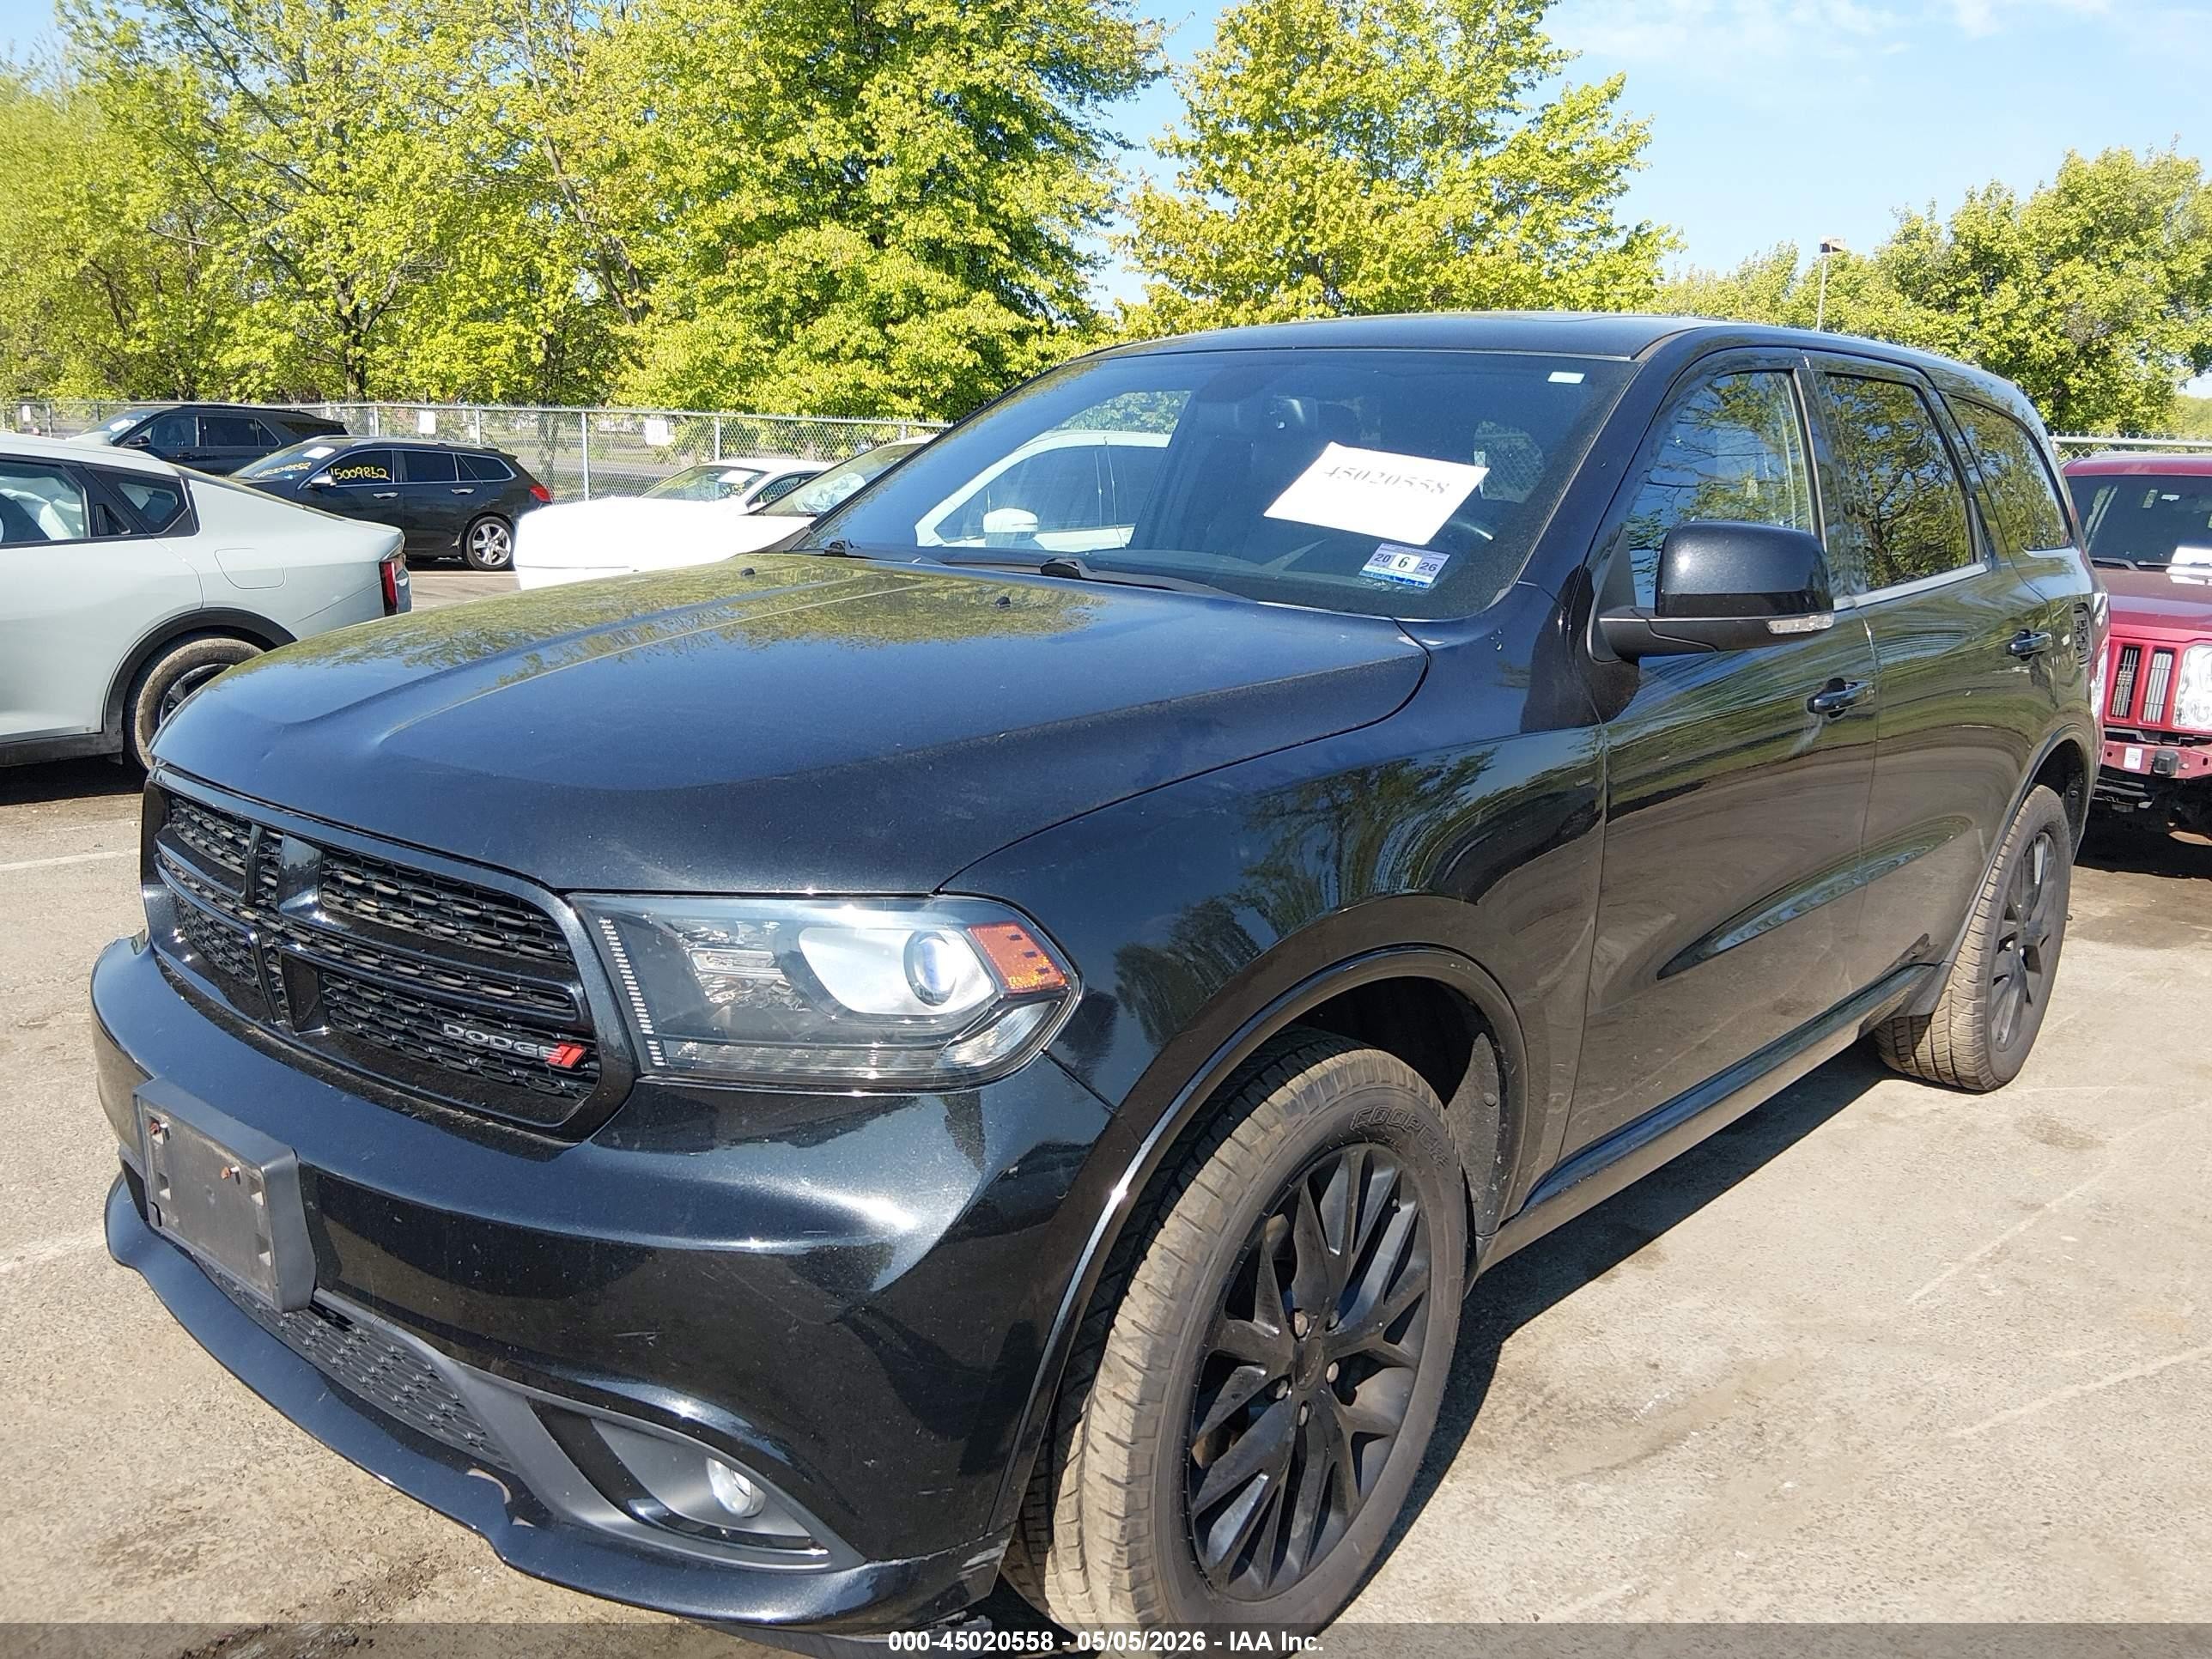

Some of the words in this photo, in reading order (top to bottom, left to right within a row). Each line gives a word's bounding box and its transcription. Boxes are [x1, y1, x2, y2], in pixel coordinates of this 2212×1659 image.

[1324, 466, 1450, 494] 45020558
[1374, 553, 1392, 563] 20
[1397, 556, 1411, 568] 6
[1419, 562, 1438, 572] 26
[443, 1023, 563, 1063] DODGE
